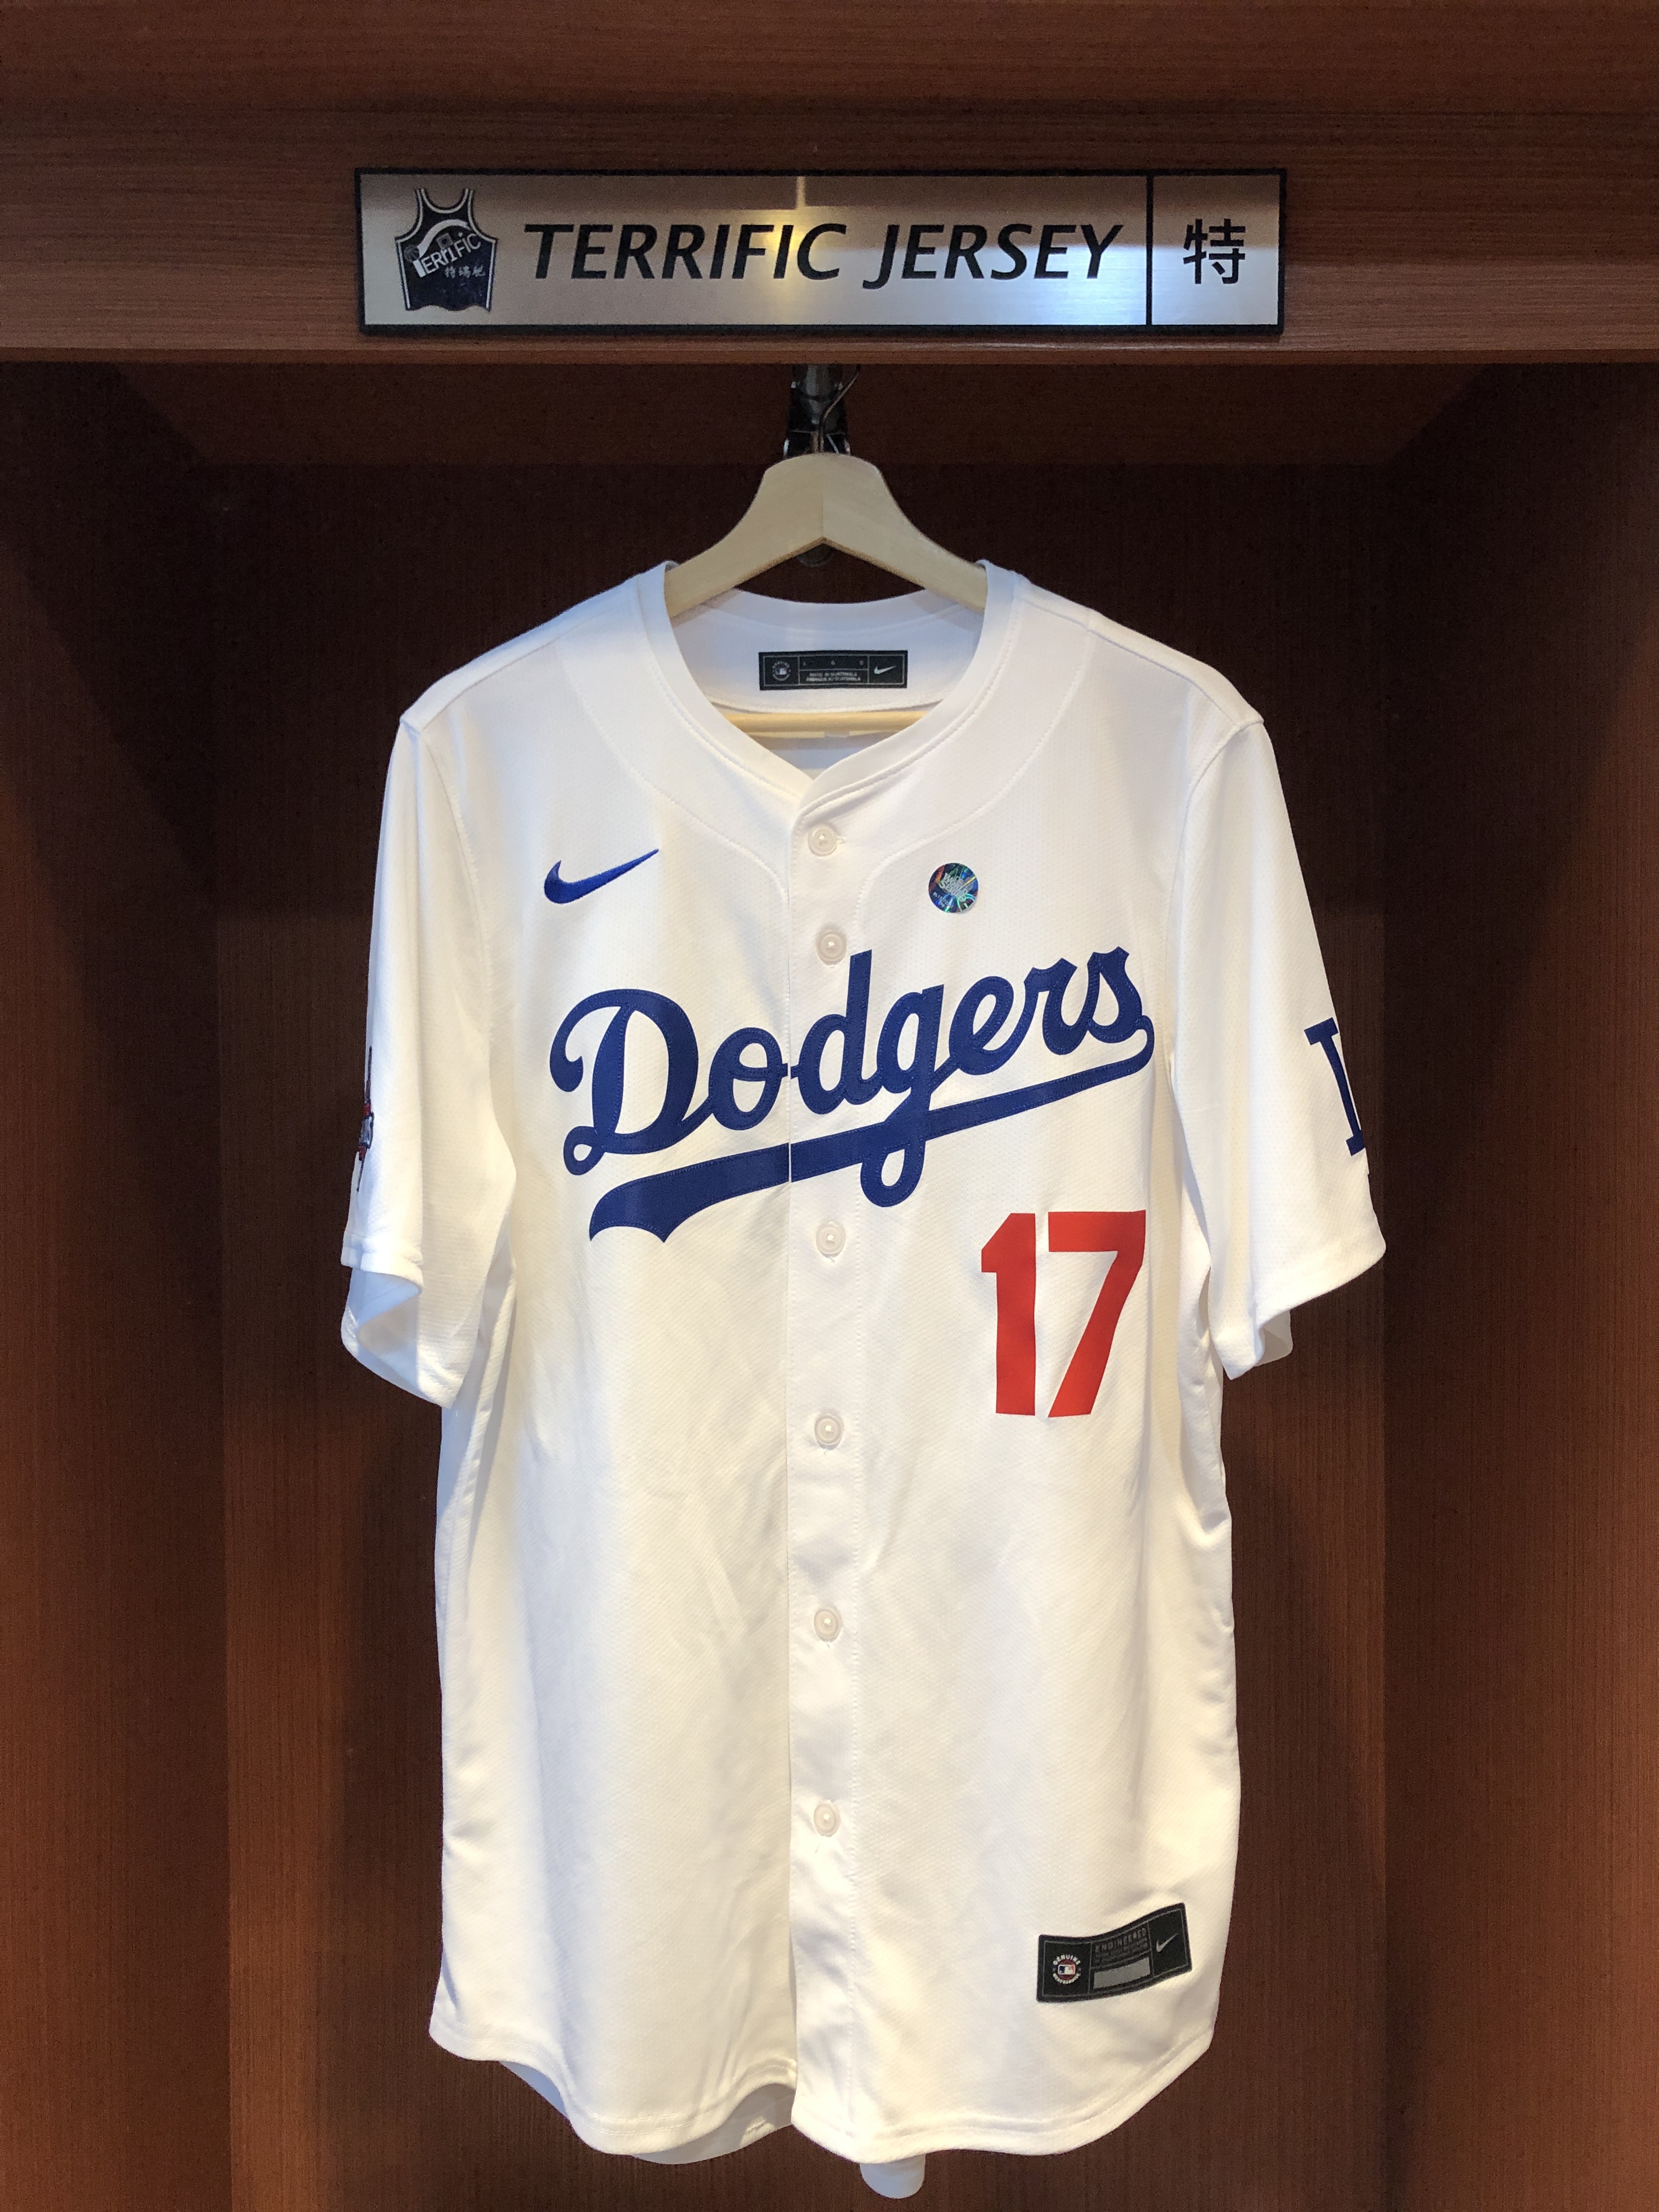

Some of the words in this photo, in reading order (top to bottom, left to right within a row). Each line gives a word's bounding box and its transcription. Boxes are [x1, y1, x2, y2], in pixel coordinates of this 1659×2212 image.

[524, 223, 848, 280] TERRIFIC
[862, 223, 1125, 290] JERSEY
[1183, 218, 1246, 285] 特
[550, 947, 1154, 1243] Dodgers
[981, 1210, 1147, 1418] 17
